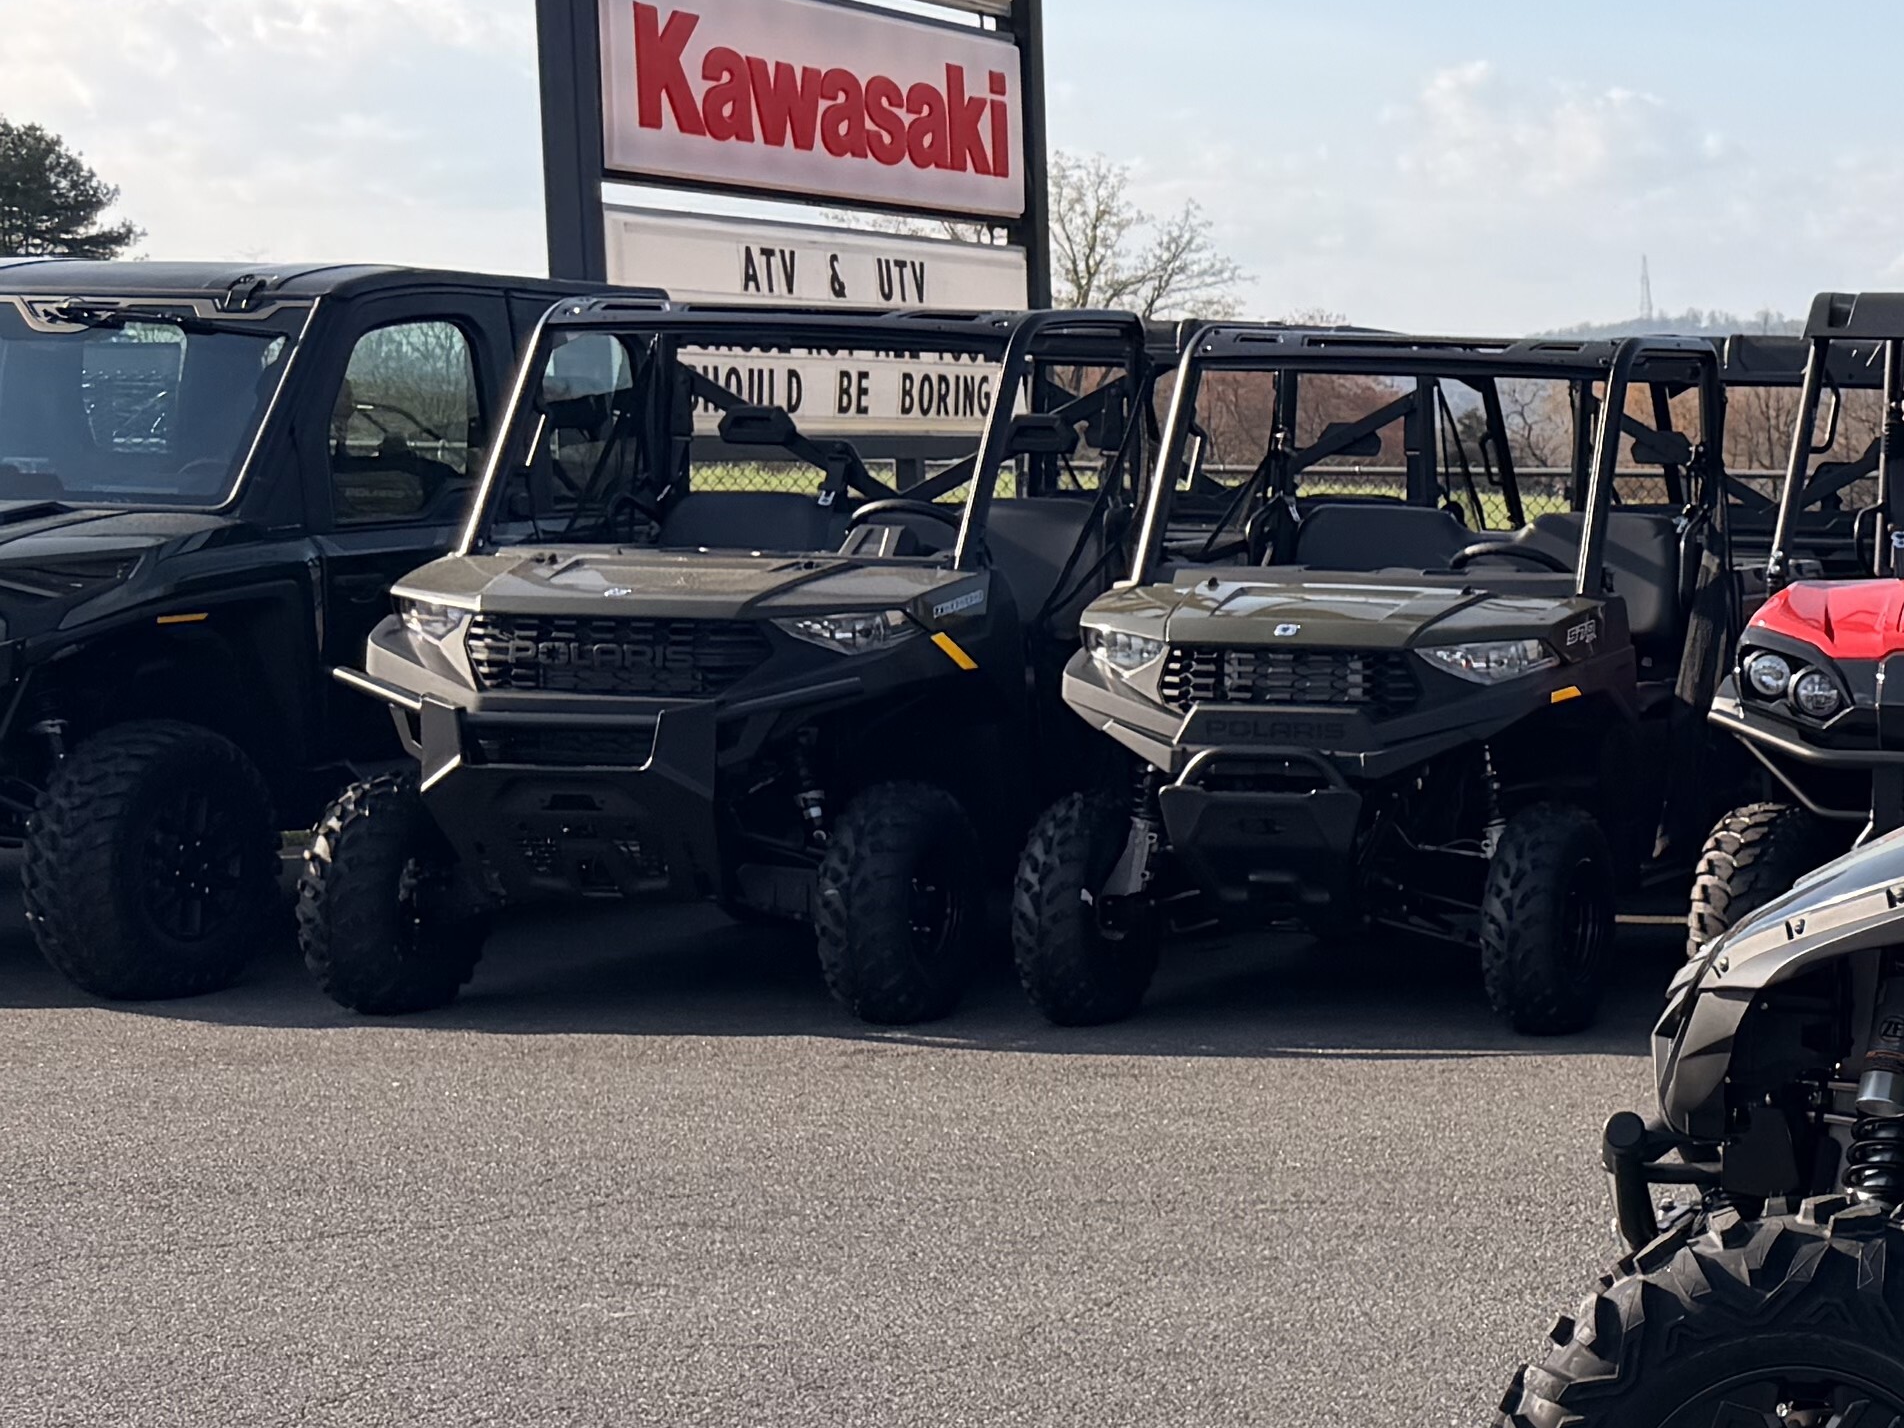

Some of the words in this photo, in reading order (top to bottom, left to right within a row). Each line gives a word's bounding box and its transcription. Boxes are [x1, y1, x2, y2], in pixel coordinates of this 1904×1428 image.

[633, 1, 1010, 179] Kawasaki
[743, 245, 796, 295] ATV
[829, 253, 847, 298] &
[876, 257, 925, 304] UTV
[837, 370, 870, 415] BE
[901, 373, 991, 418] BORING
[508, 640, 697, 668] POLARIS
[1205, 719, 1345, 739] POLARIS
